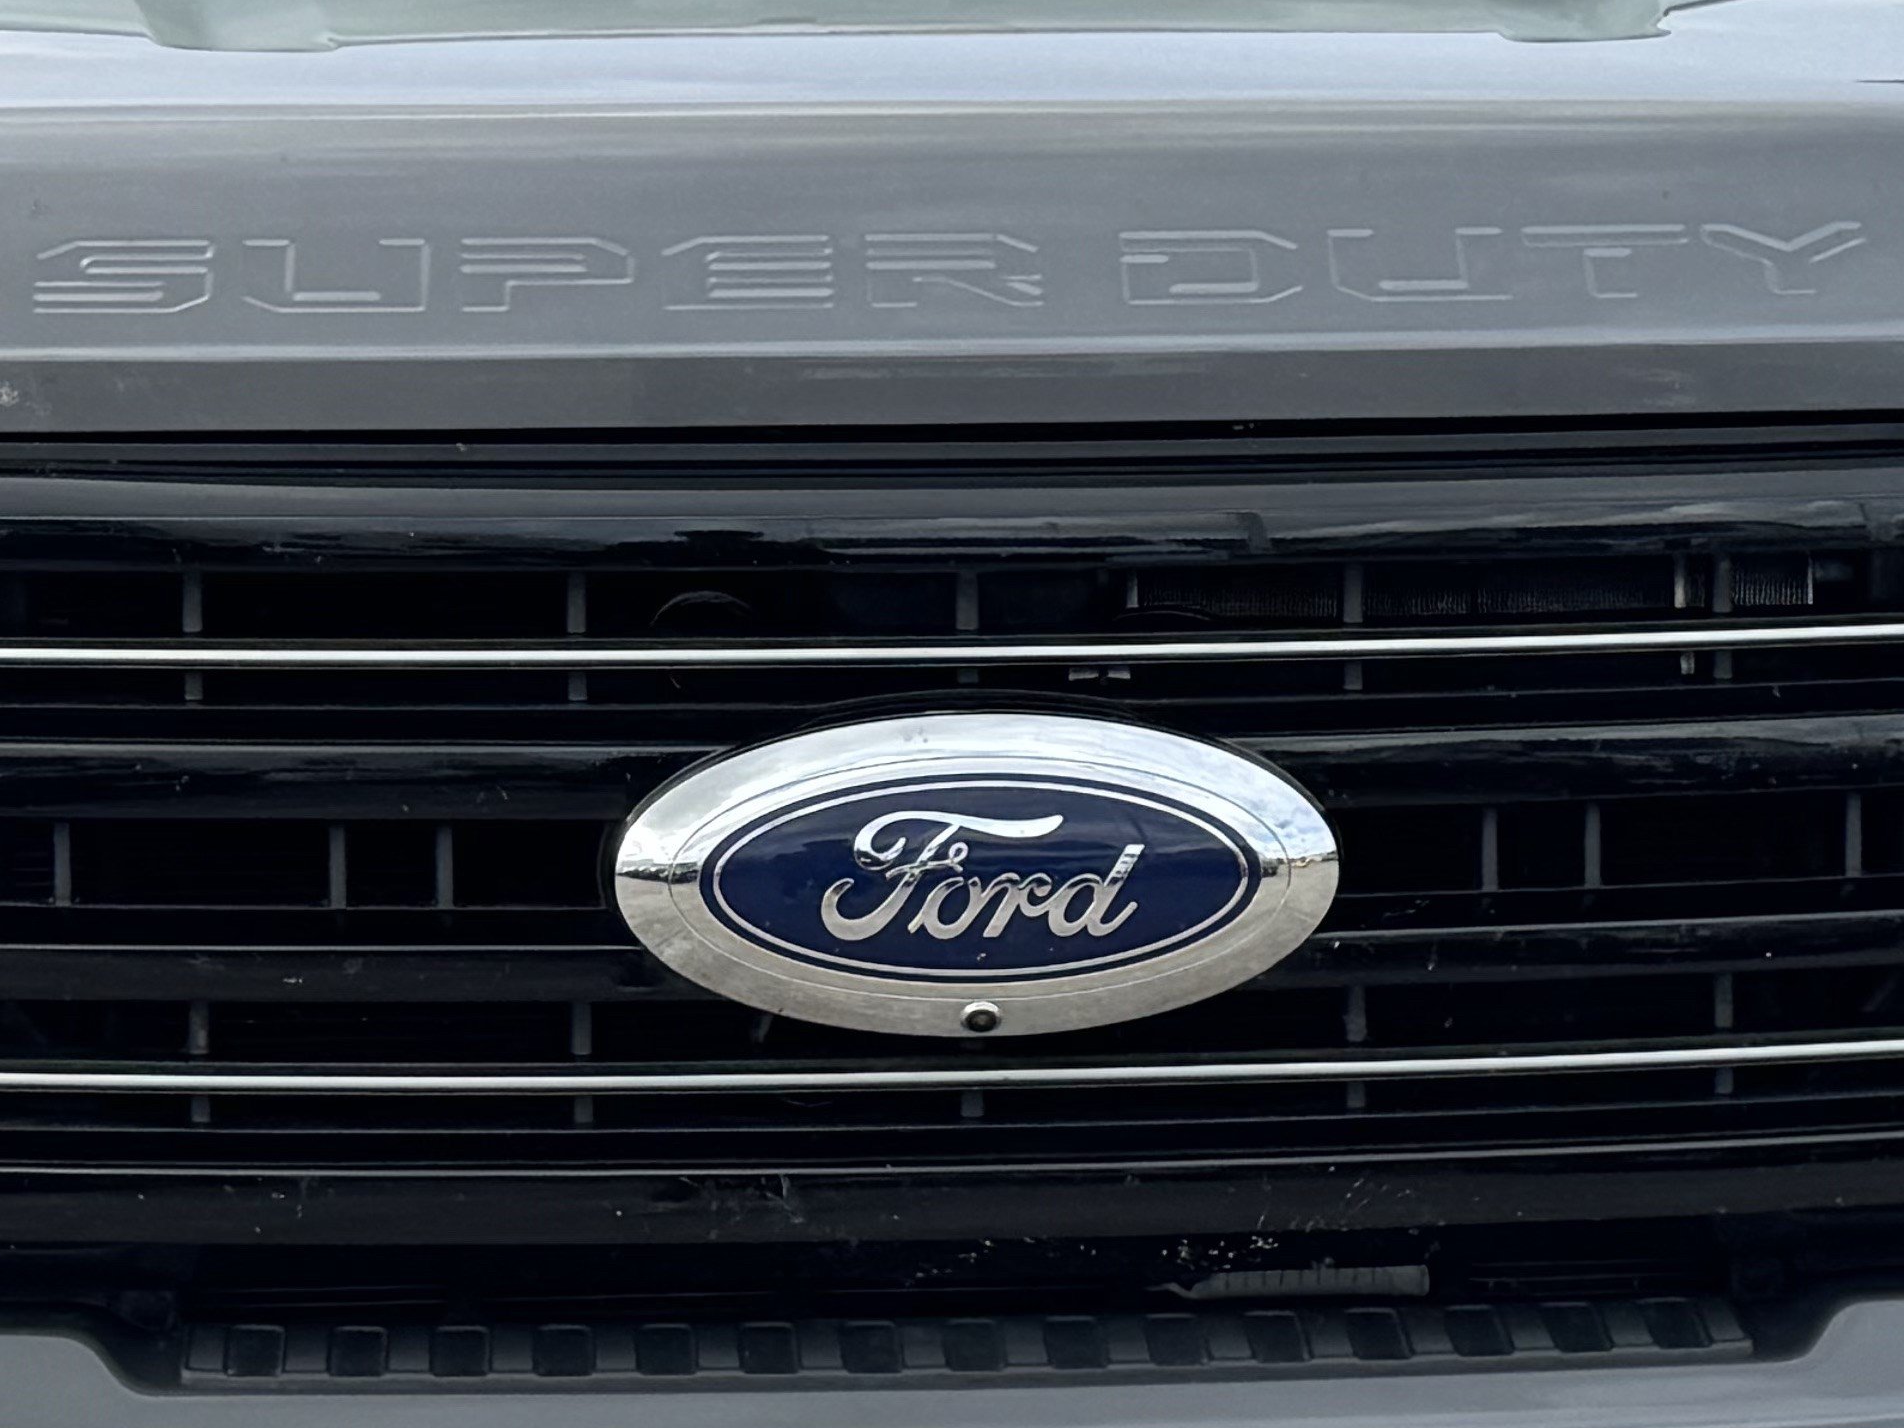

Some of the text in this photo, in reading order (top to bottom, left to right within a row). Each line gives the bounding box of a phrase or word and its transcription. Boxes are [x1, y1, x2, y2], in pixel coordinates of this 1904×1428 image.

[32, 222, 1867, 315] SUPER DUTY
[820, 810, 1146, 941] Ford
